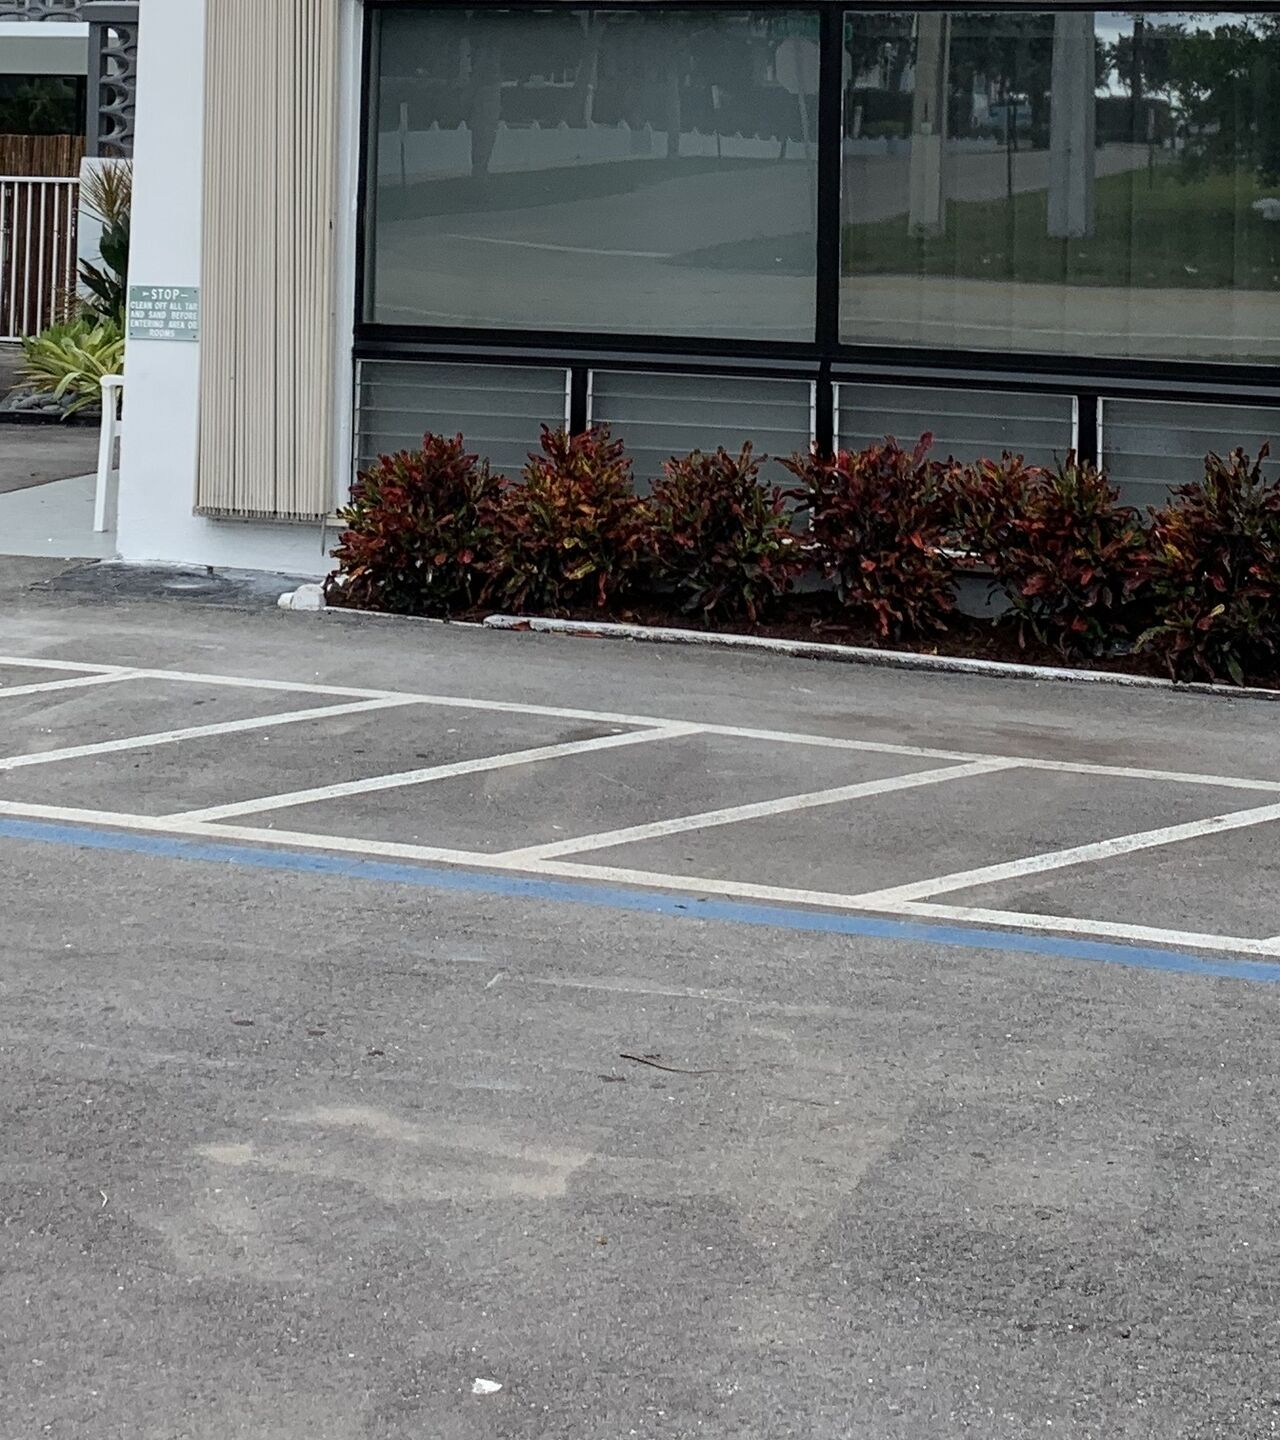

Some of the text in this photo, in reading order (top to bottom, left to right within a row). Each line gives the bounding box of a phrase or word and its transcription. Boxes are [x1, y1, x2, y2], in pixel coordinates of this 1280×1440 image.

[151, 288, 180, 300] STOP
[130, 301, 153, 310] CLEAN
[154, 301, 168, 310] OFF
[169, 302, 182, 310] ALL
[130, 310, 197, 320] AND SAND BEFORE
[130, 319, 164, 328] ENTERING
[148, 328, 176, 337] ROOMS
